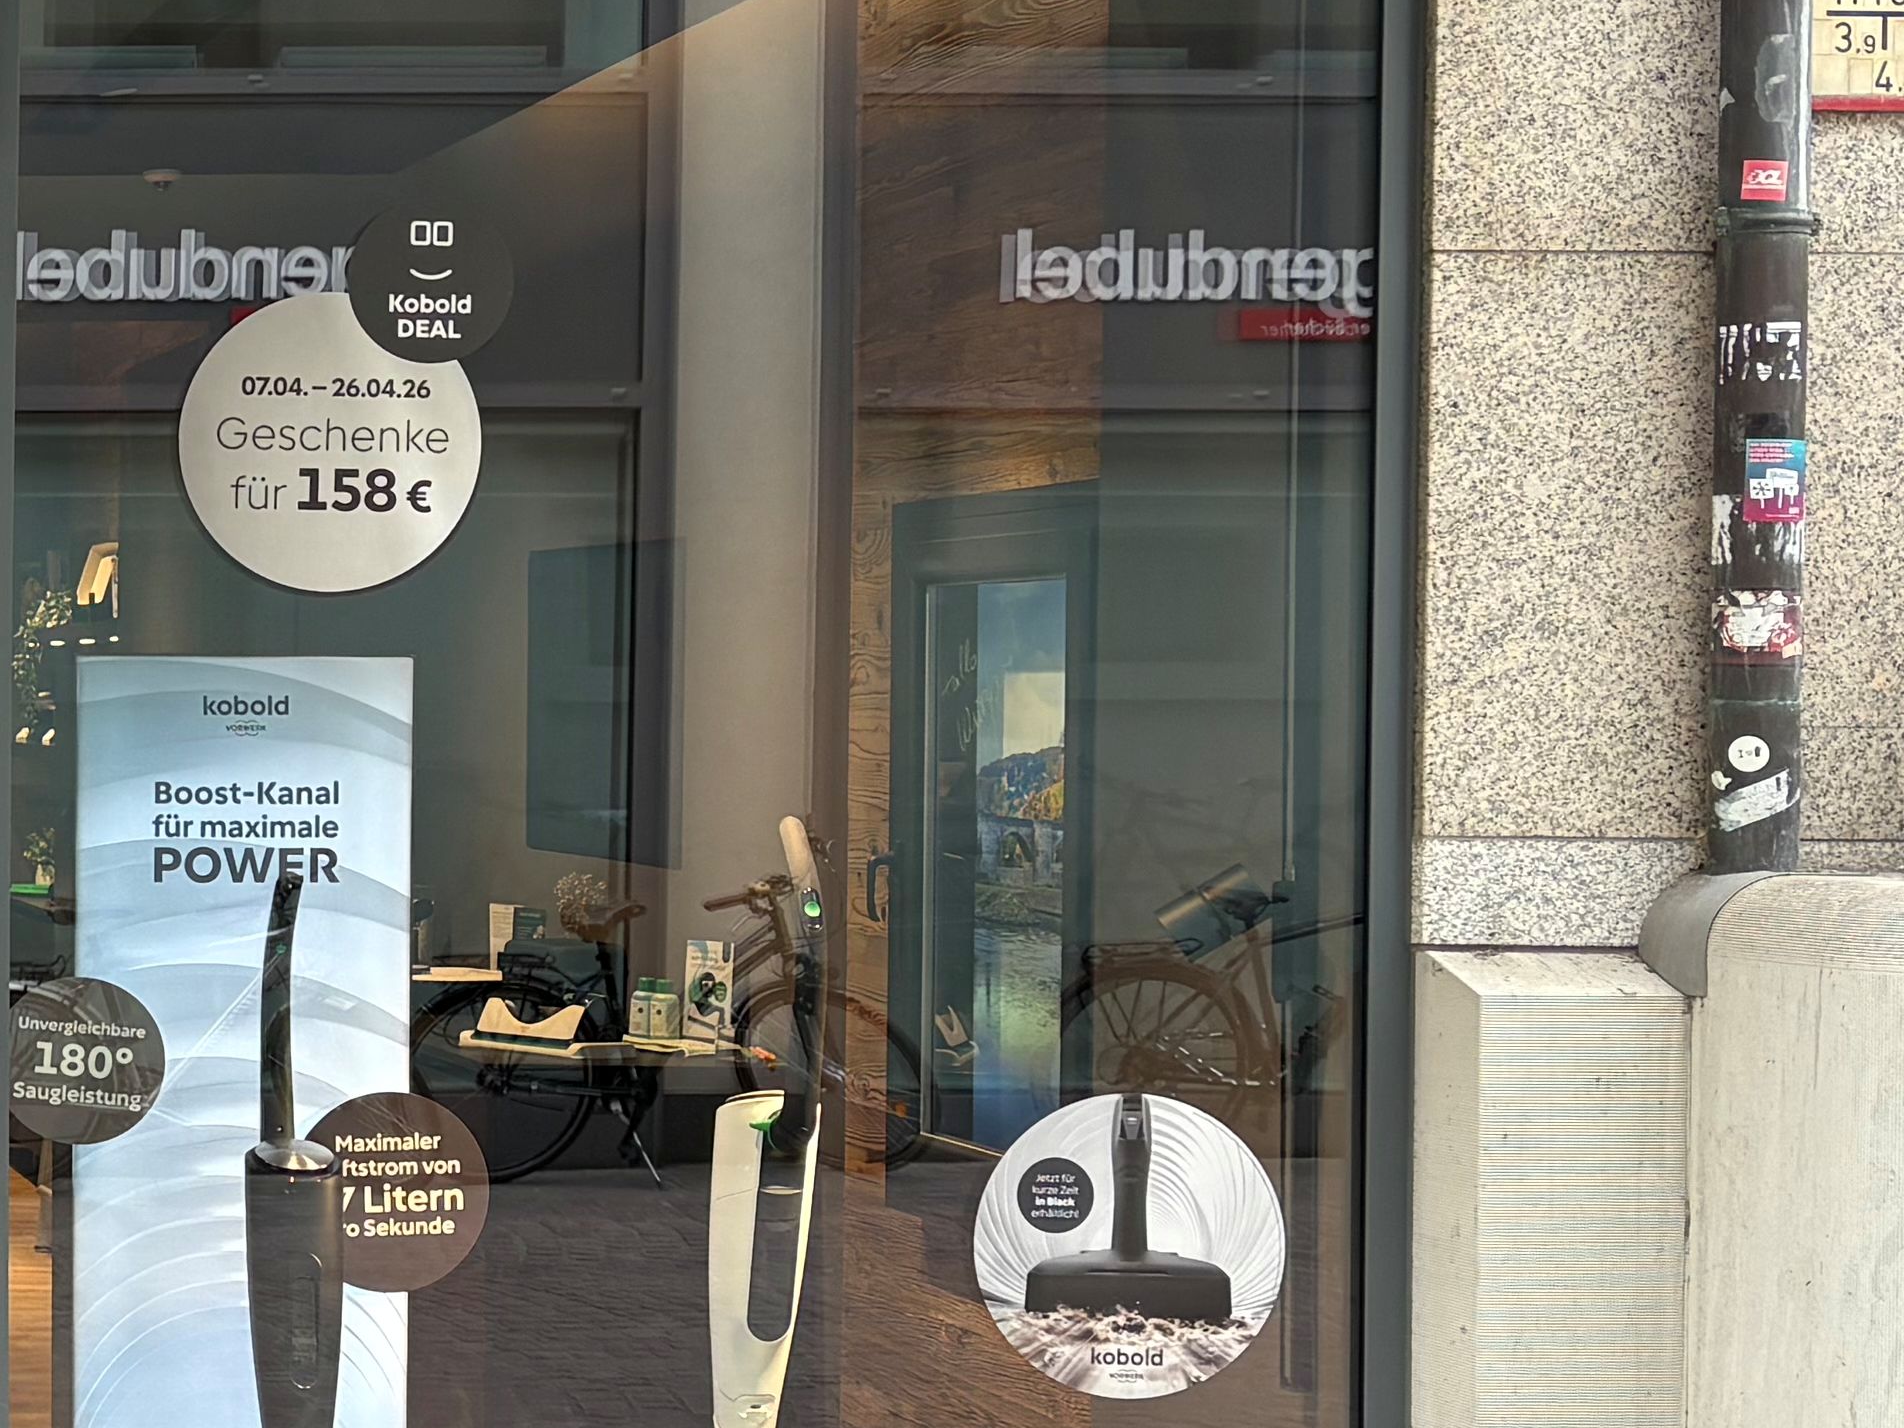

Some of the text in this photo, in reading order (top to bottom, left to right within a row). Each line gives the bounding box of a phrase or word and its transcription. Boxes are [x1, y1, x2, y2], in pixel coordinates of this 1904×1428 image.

[388, 293, 472, 315] Kobold
[396, 318, 462, 340] DEAL
[331, 377, 431, 400] 26.04.26
[216, 416, 449, 454] Geschenke
[230, 475, 288, 510] für
[296, 468, 398, 514] 158
[202, 695, 290, 716] kobold
[154, 780, 340, 805] Boost-Kanal
[152, 814, 340, 838] für maximale
[153, 846, 341, 884] POWER
[17, 1015, 147, 1039] Unvergleichbare
[33, 1040, 135, 1080] 180°
[12, 1081, 142, 1112] Saugleistung
[335, 1132, 442, 1153] Maximaler
[342, 1159, 461, 1177] ftstrom von
[342, 1183, 465, 1214] 7 Litern
[342, 1216, 456, 1238] o Sekunde
[1090, 1347, 1164, 1366] kobold
